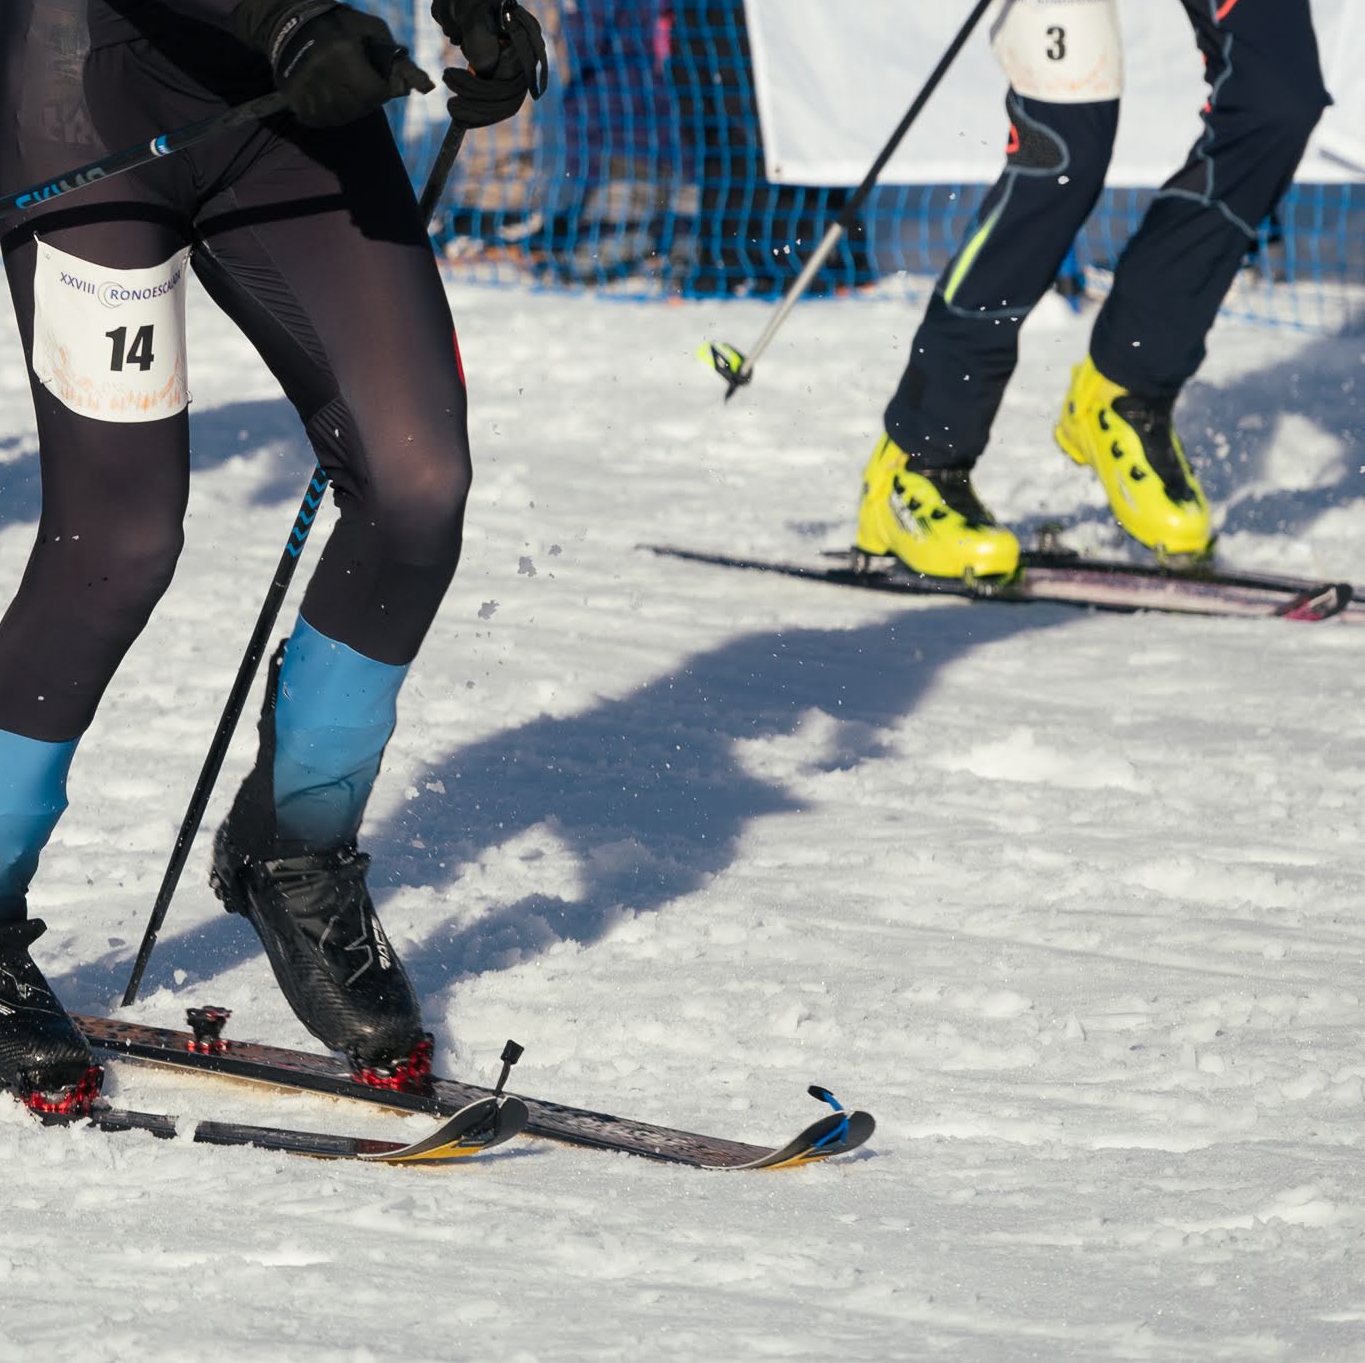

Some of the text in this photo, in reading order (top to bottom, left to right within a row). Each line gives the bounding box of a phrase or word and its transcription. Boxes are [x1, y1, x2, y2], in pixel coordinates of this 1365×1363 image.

[1046, 26, 1066, 60] 3
[60, 271, 95, 295] XXVIII
[105, 324, 155, 372] 14
